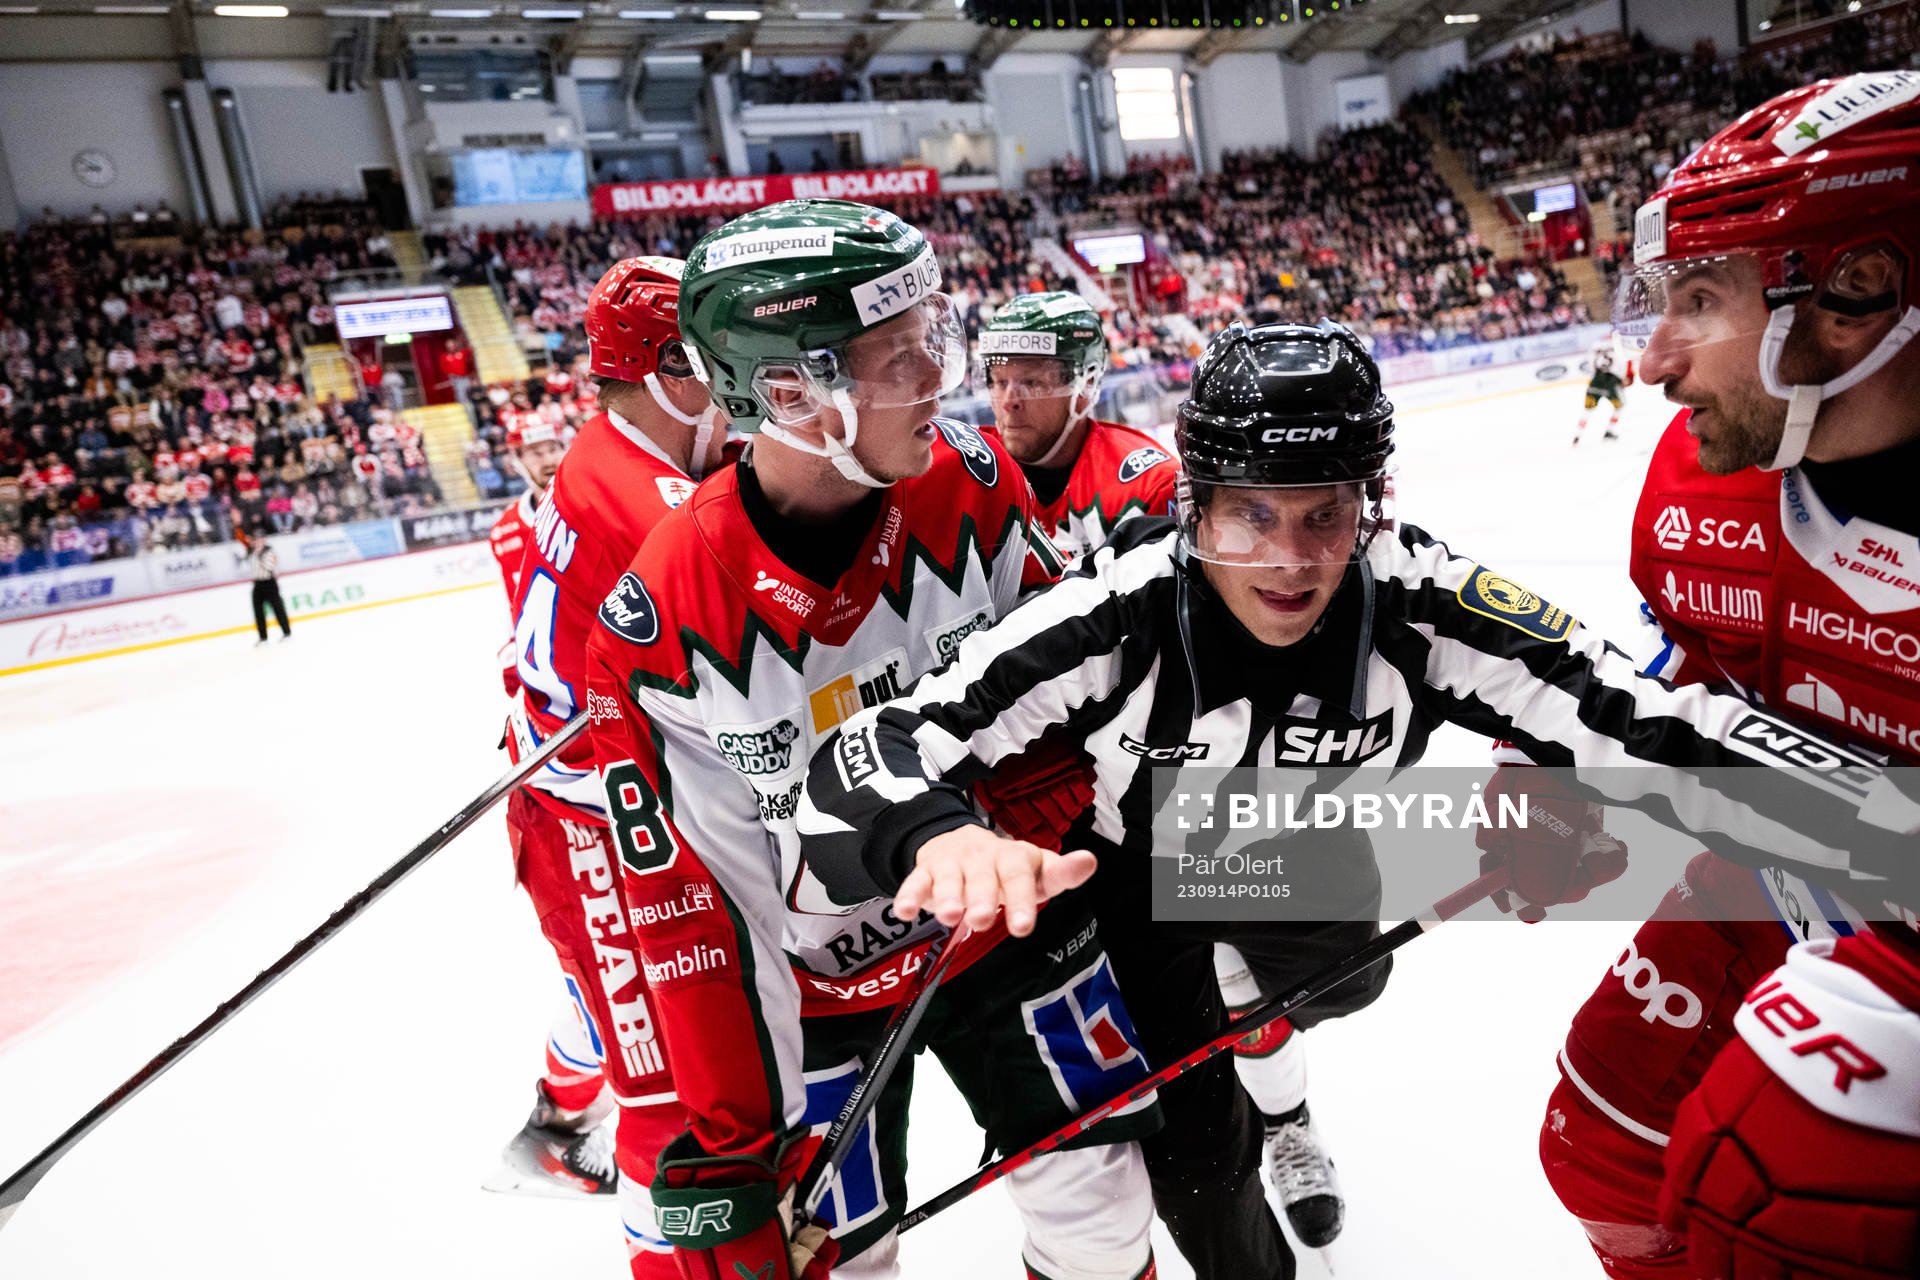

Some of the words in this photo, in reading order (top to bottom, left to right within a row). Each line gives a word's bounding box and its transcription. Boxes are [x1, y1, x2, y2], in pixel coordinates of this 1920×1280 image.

[1805, 166, 1908, 195] BAUER
[730, 235, 826, 258] Tranpenad
[754, 296, 817, 318] BAUER
[982, 335, 1052, 351] BURFORS
[1261, 426, 1338, 444] CCM
[881, 506, 899, 541] INTER
[1697, 518, 1766, 552] SCA
[1858, 538, 1904, 567] SHL
[1848, 562, 1920, 597] BAUER
[602, 577, 645, 628] Ford
[772, 590, 813, 619] SPORT
[778, 582, 816, 611] INTER
[1687, 580, 1763, 622] LILIUM
[1690, 612, 1764, 631] FASTIGHETER
[1788, 602, 1920, 663] HIGHCO
[717, 733, 774, 755] CASH
[843, 730, 874, 779] CCM
[1120, 739, 1206, 760] CCM
[1279, 724, 1390, 763] SHL
[724, 747, 791, 775] BUDDY
[1738, 722, 1878, 795] CCM
[1532, 805, 1574, 836] ULTRA
[684, 884, 711, 897] FILM
[569, 840, 657, 1050] PEAB
